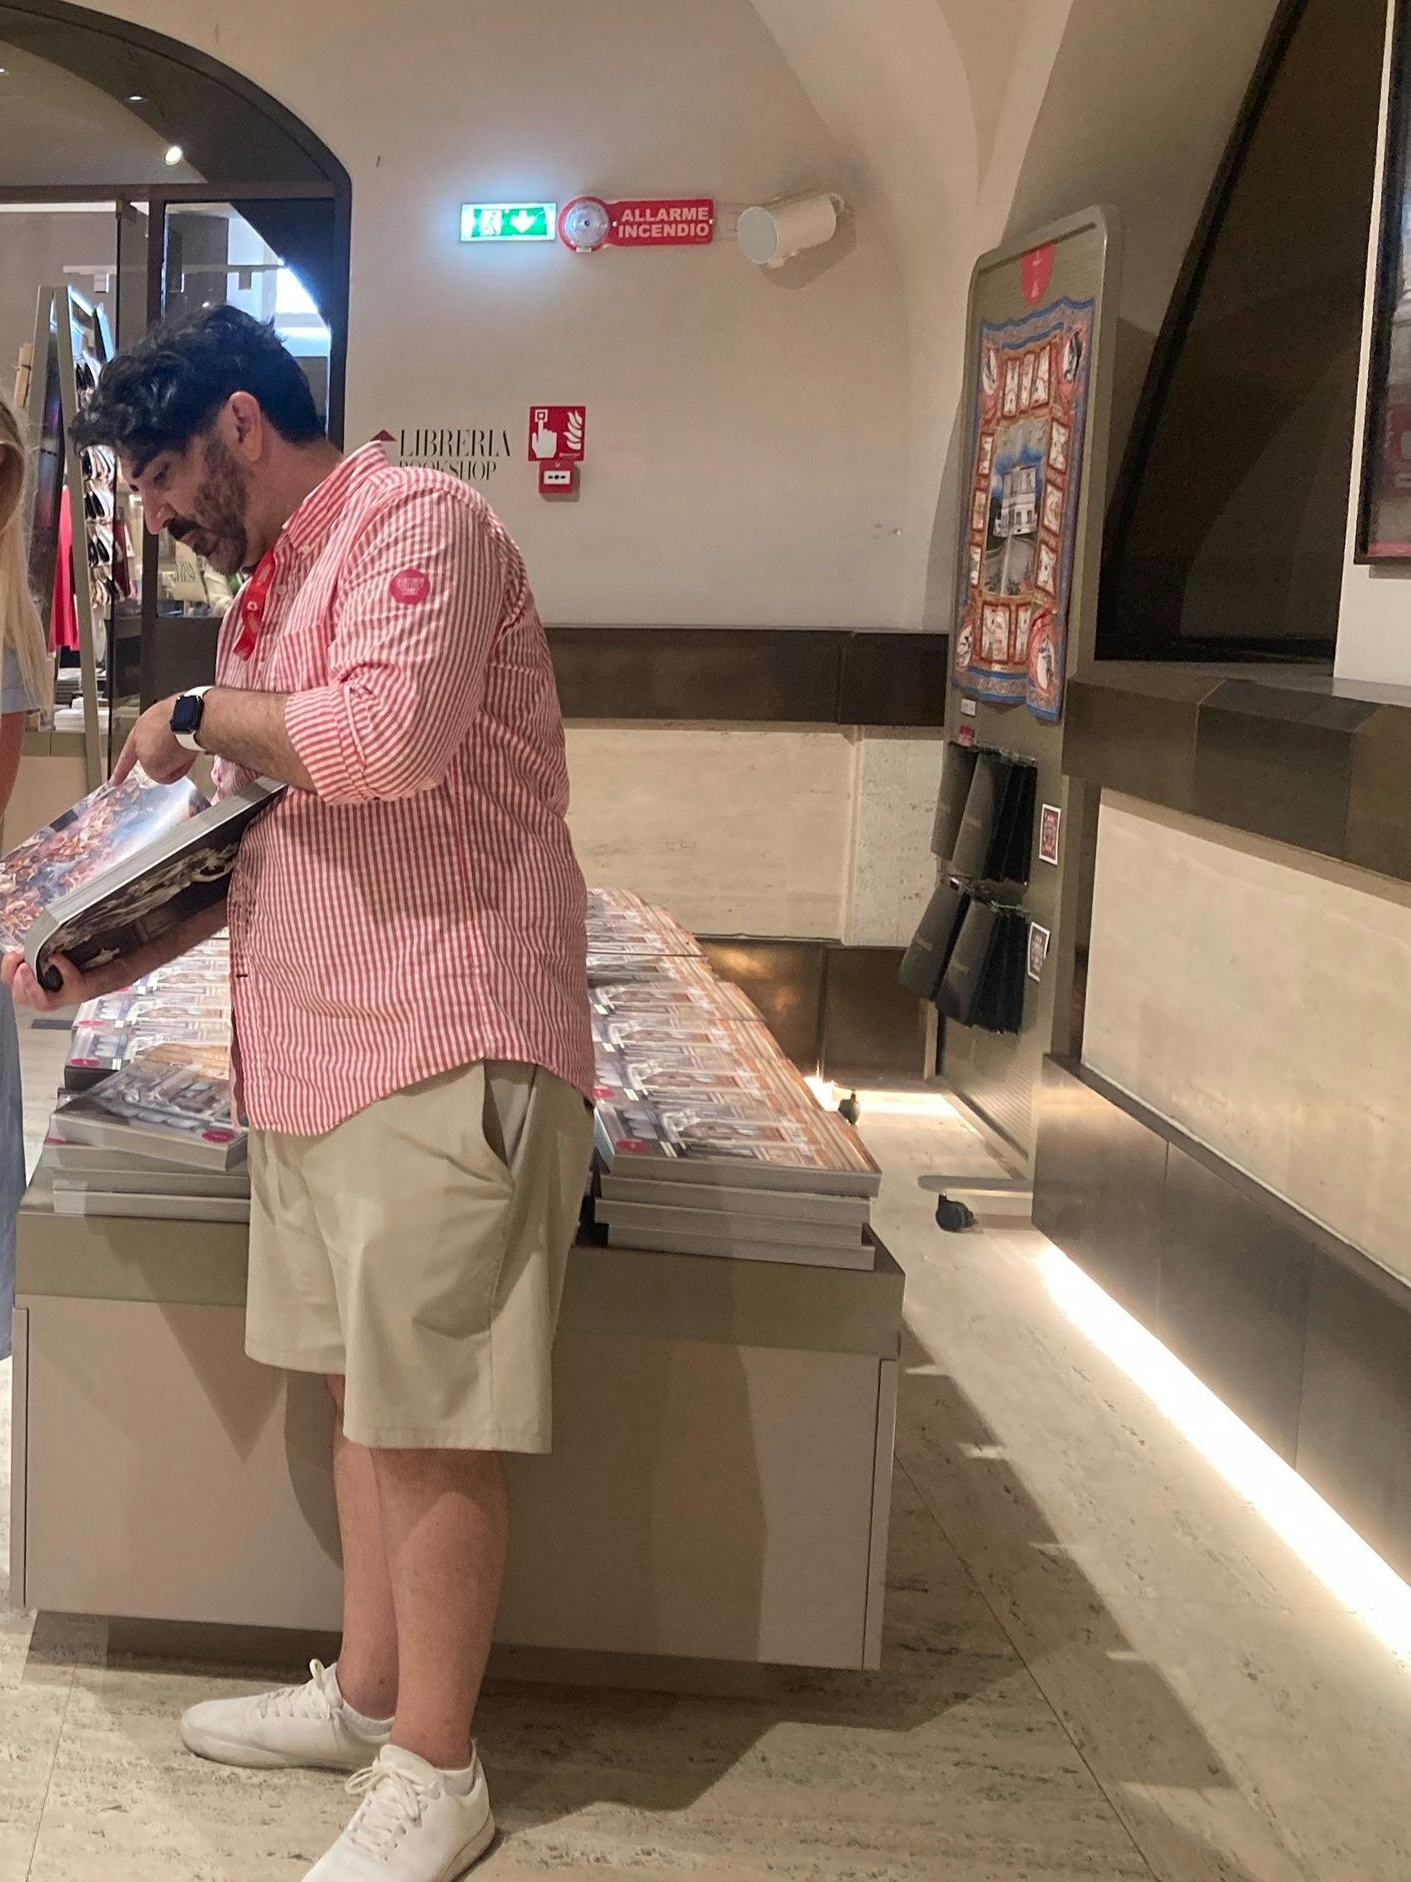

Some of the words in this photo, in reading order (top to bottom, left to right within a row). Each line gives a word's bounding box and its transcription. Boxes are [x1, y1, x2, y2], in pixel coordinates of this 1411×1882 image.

[621, 207, 709, 222] ALLARME
[618, 223, 709, 238] INCENDIO
[399, 429, 510, 457] LIBRERIA
[399, 461, 497, 480] KSHOP
